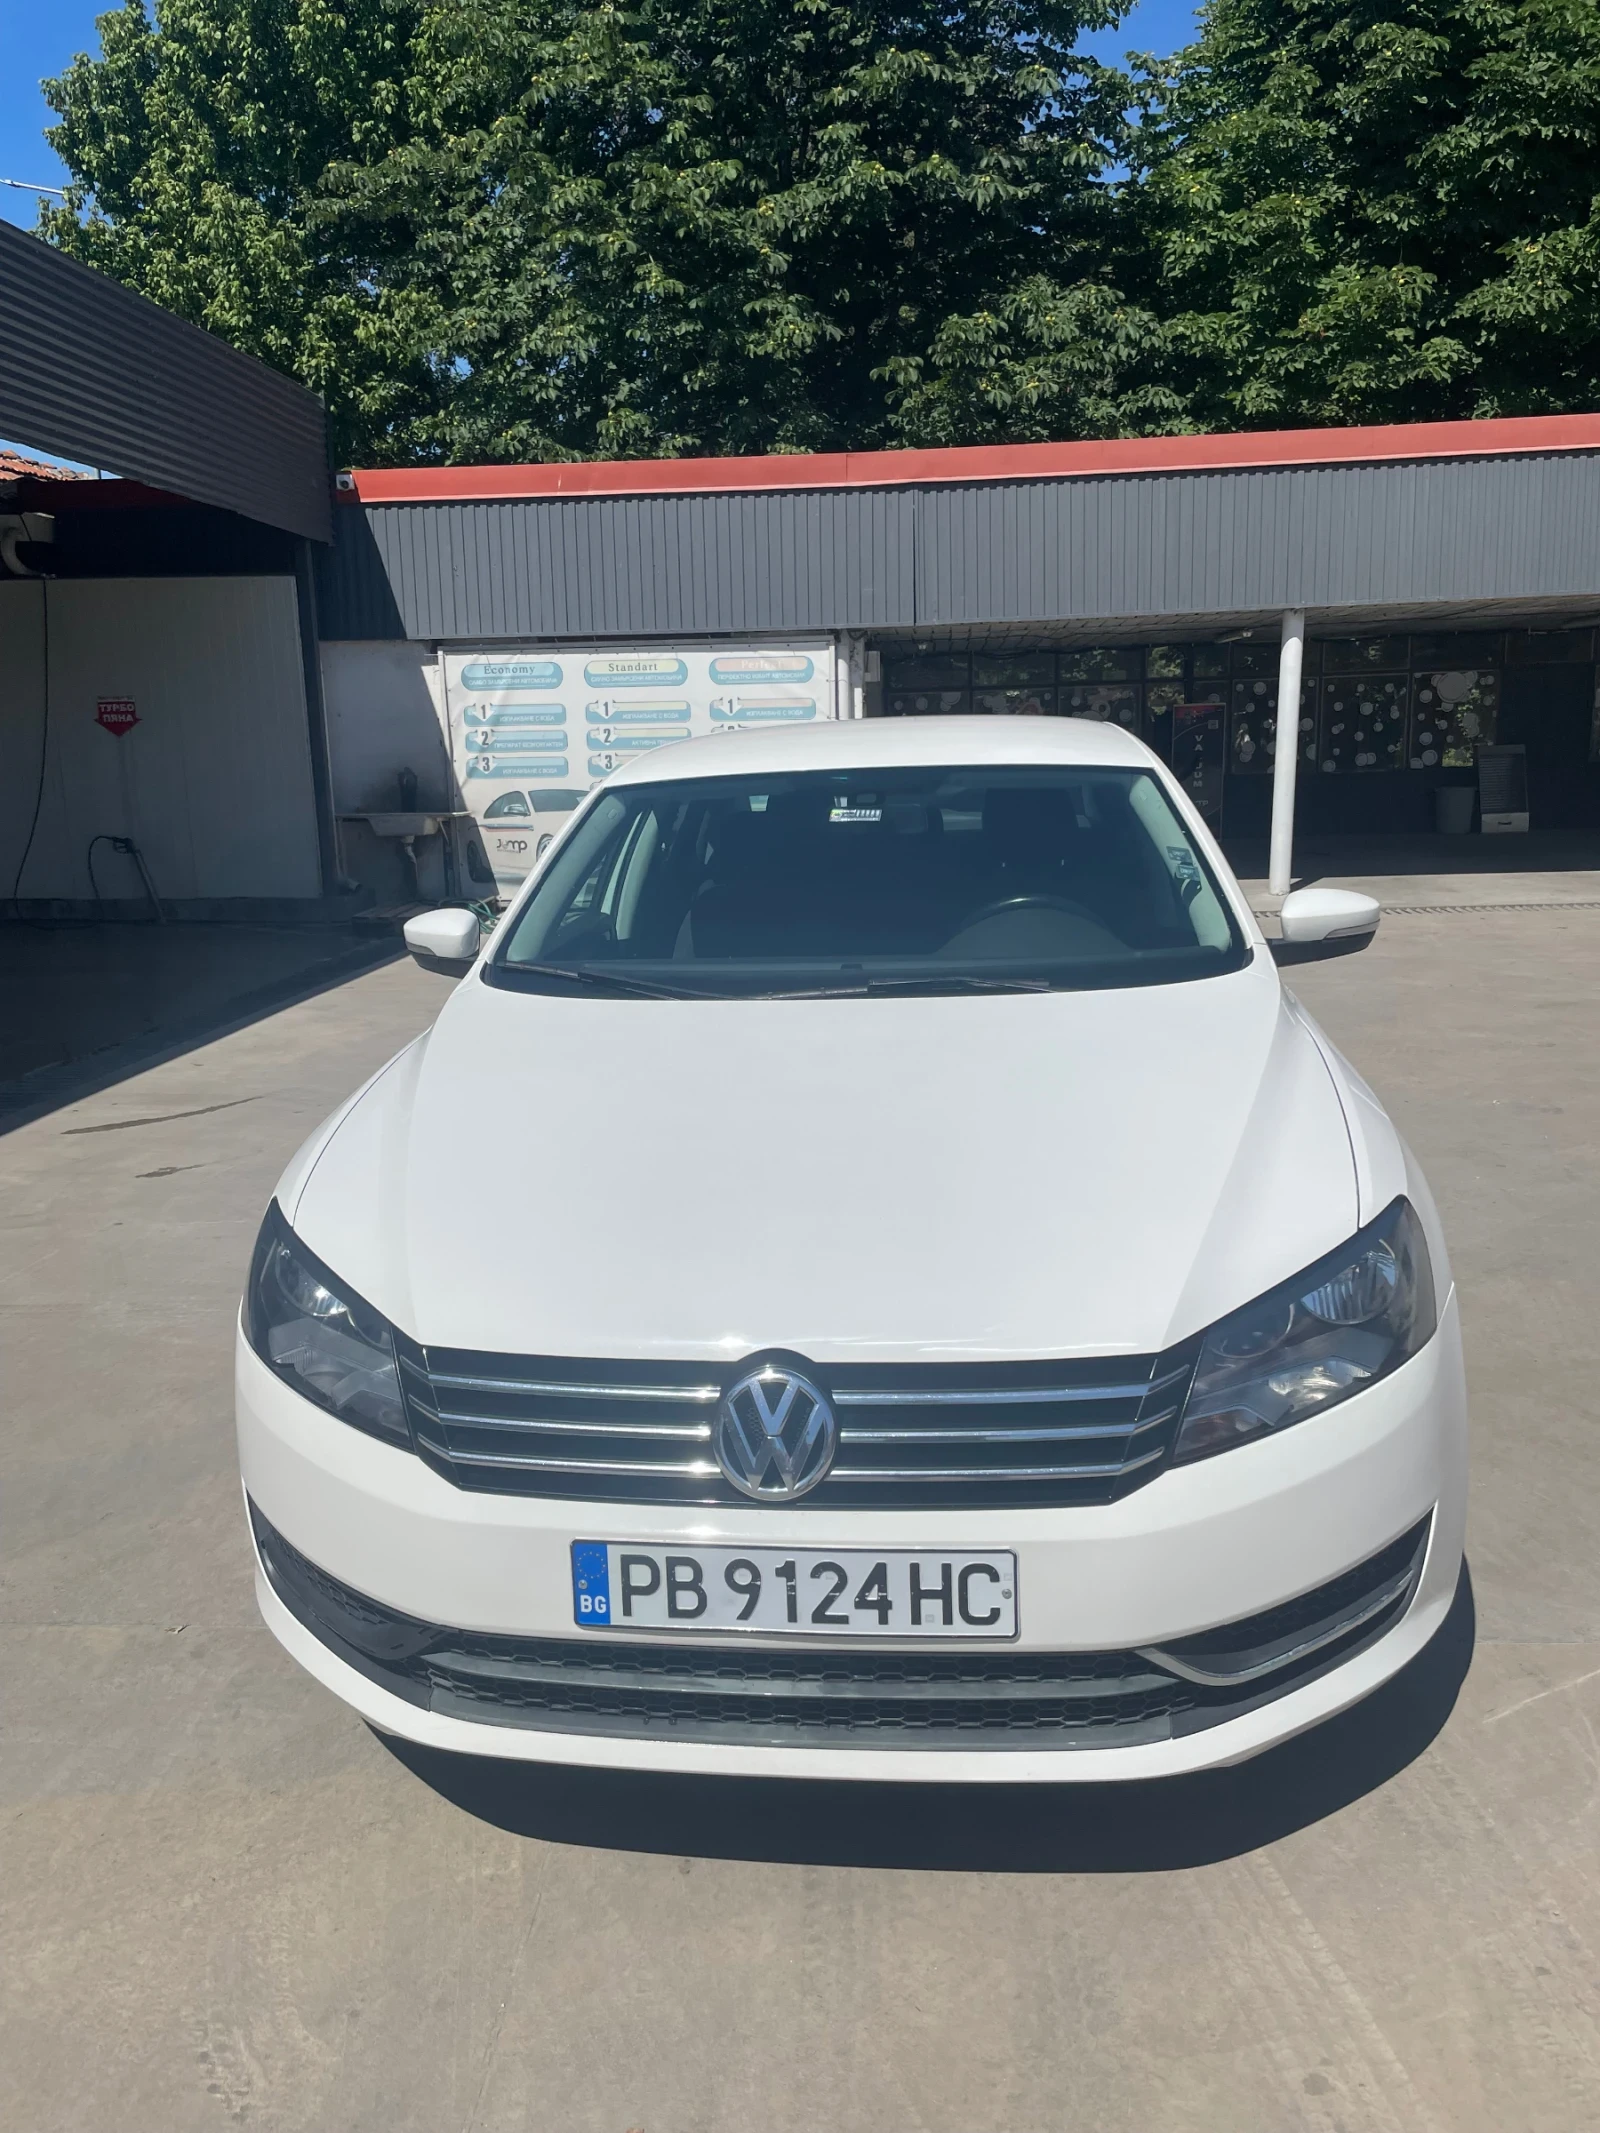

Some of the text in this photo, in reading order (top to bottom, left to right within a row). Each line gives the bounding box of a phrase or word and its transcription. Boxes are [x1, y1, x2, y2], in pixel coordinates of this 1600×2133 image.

[484, 665, 536, 675] Economy
[608, 662, 658, 672] Standart
[99, 703, 134, 712] ТУРБО
[480, 704, 487, 720] 1
[603, 701, 609, 717] 1
[727, 698, 733, 714] 1
[103, 714, 133, 722] ПЯНА
[481, 731, 489, 746] 2
[603, 728, 611, 743] 2
[482, 757, 490, 772] 3
[604, 754, 613, 769] 3
[579, 1553, 1001, 1627] BG PB 9124 HC
